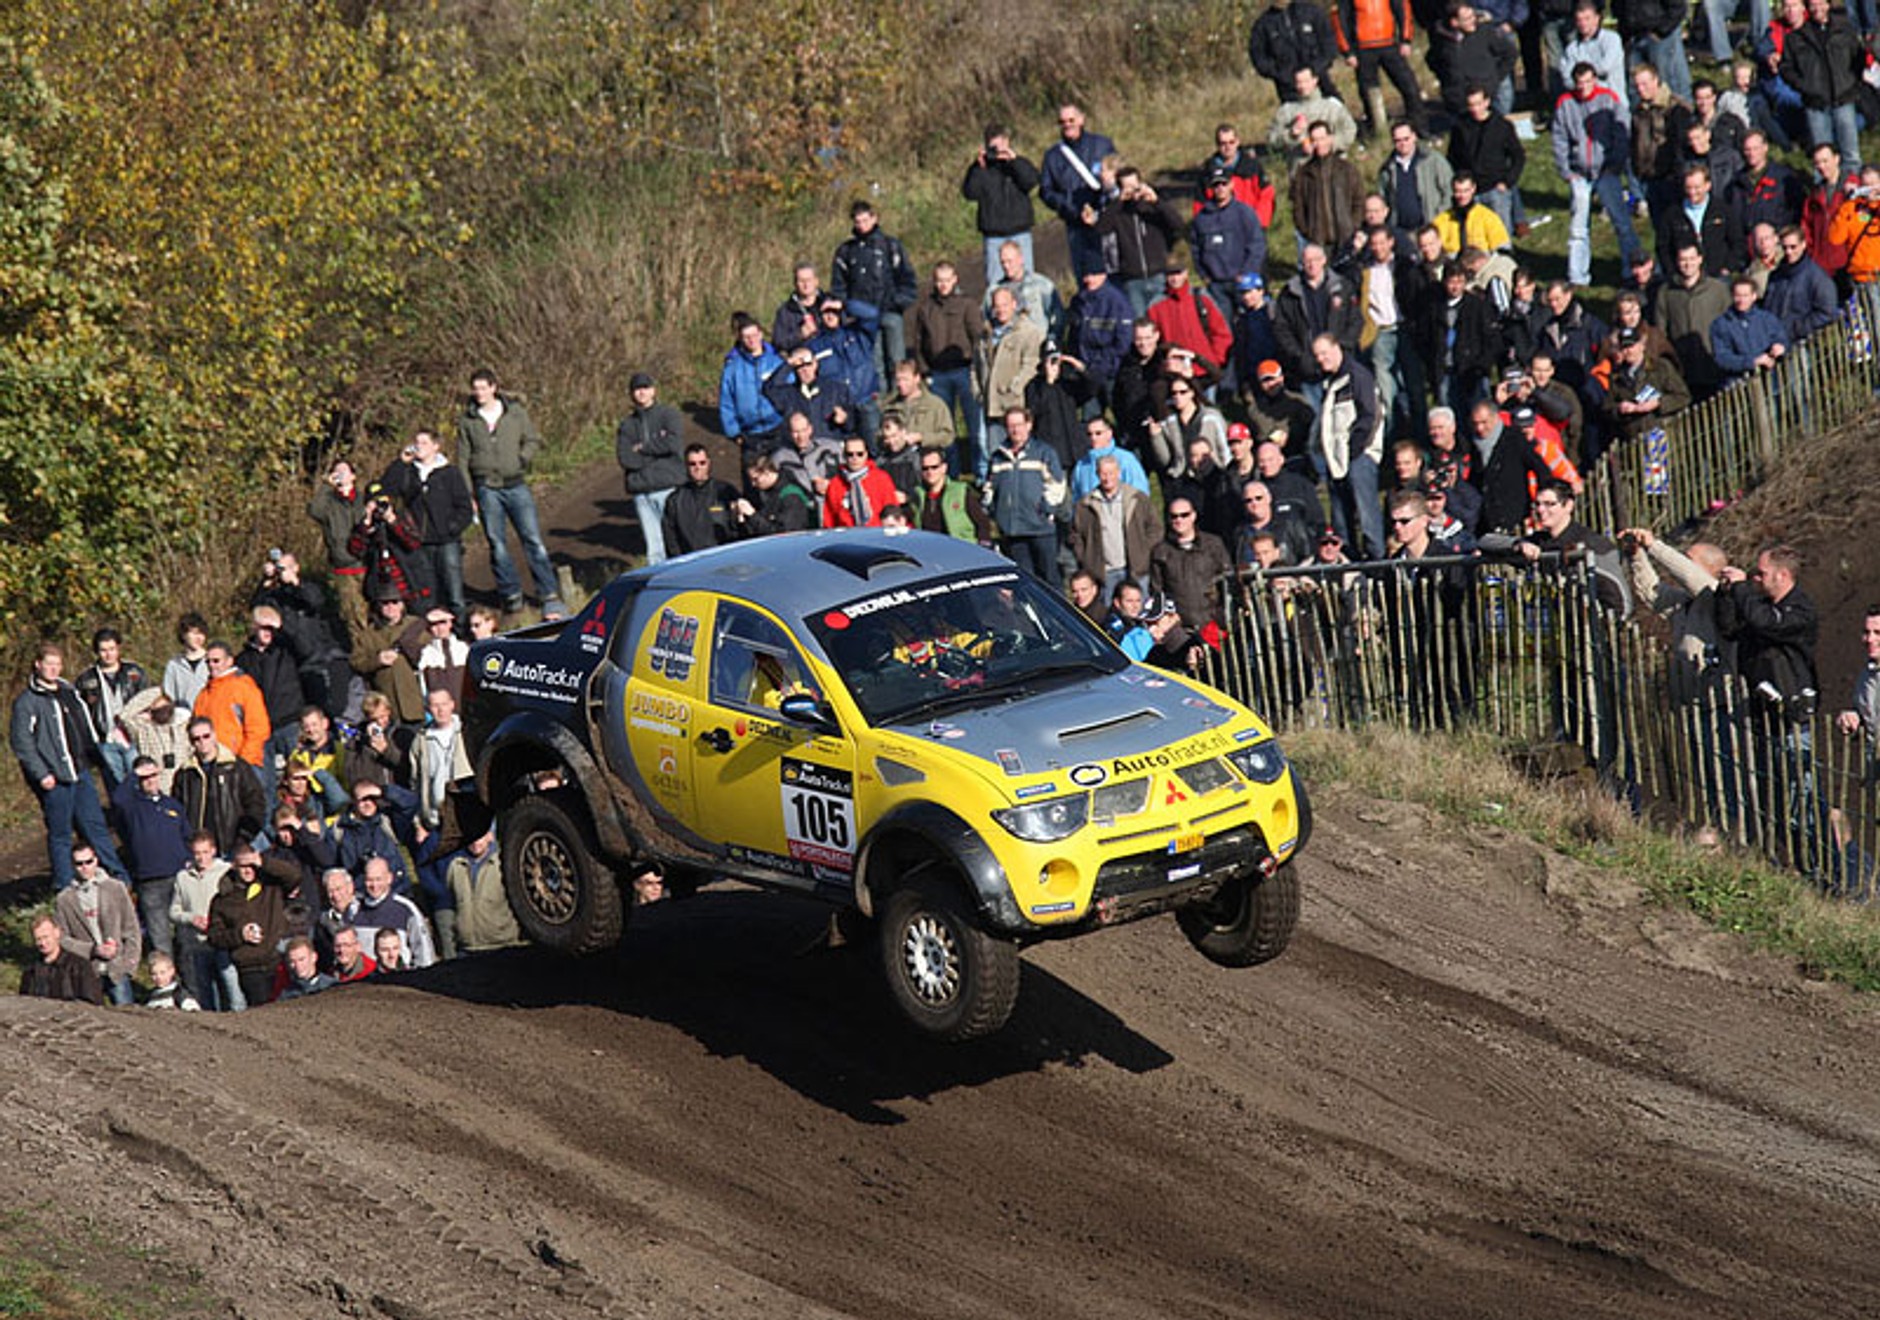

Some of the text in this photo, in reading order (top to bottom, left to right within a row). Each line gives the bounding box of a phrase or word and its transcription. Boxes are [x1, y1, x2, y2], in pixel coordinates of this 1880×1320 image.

[503, 659, 584, 689] AutoTrack.nl
[631, 692, 692, 724] JUMBO
[1113, 732, 1229, 776] AutoTrack.nl
[791, 792, 850, 849] 105
